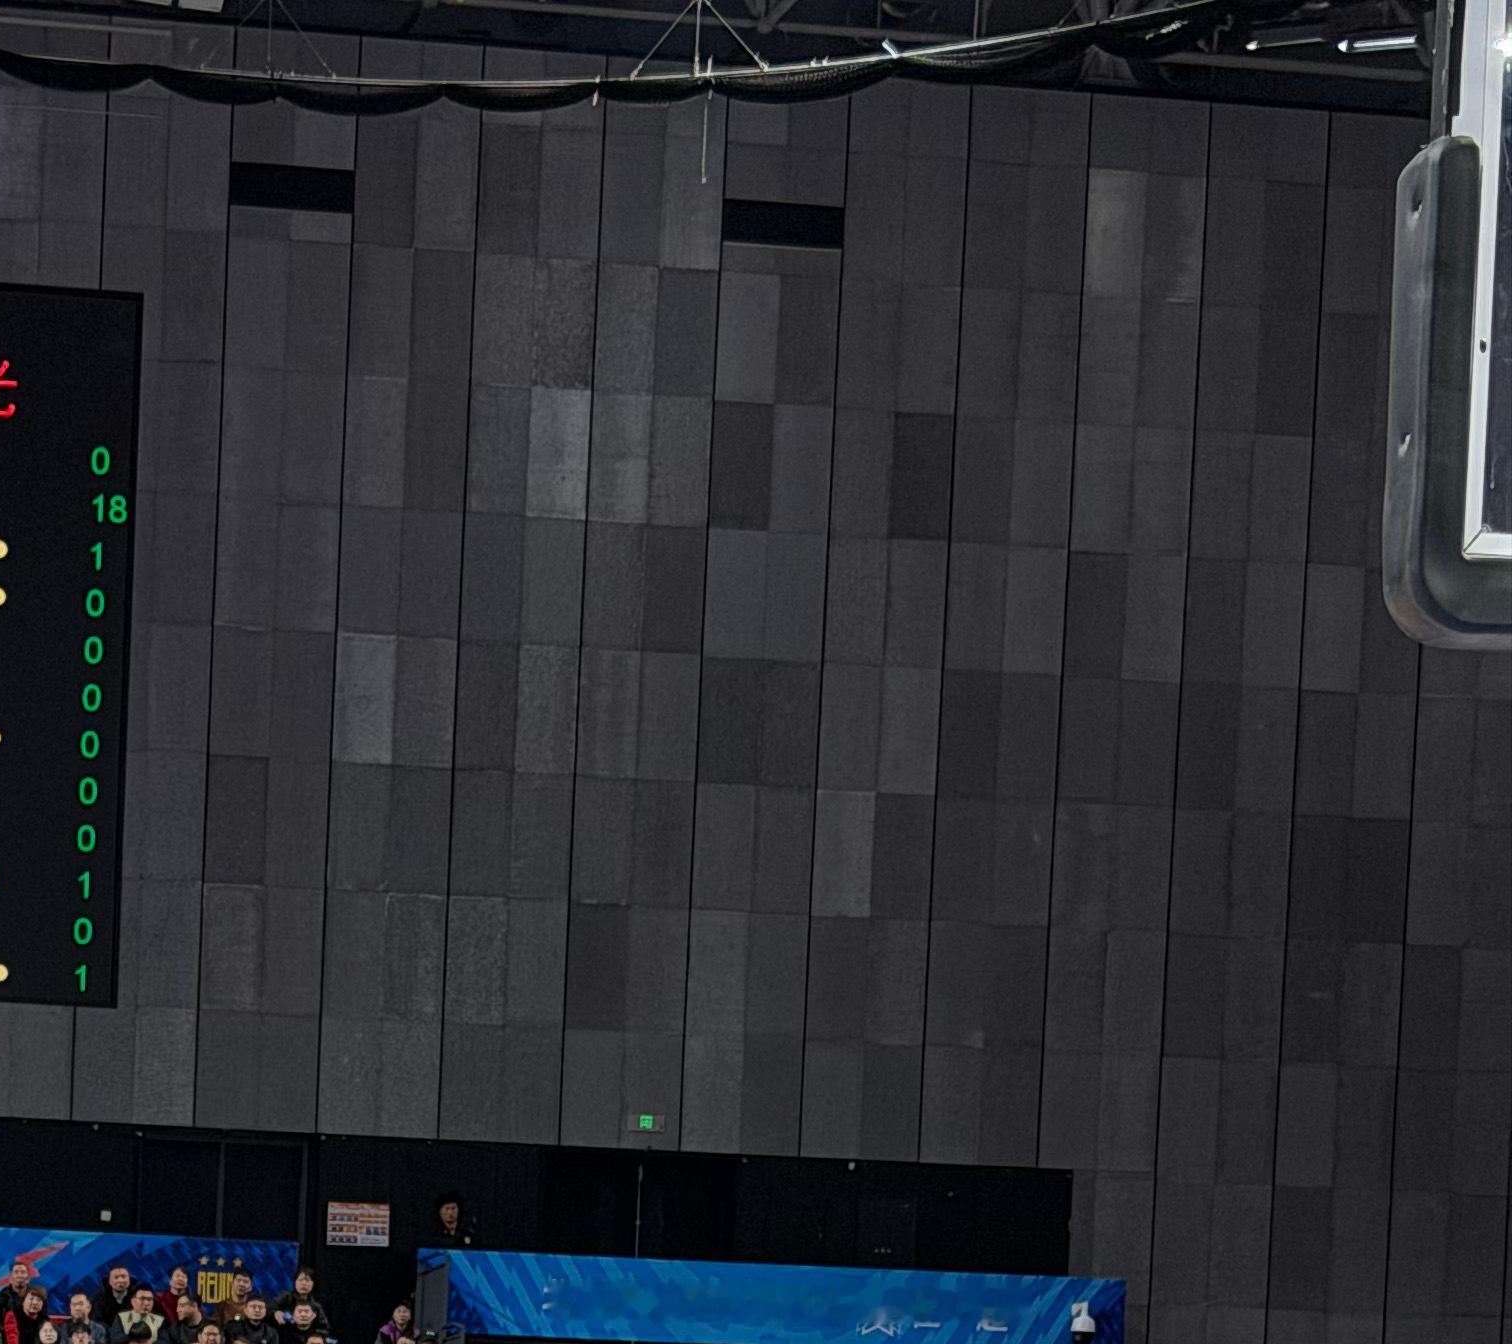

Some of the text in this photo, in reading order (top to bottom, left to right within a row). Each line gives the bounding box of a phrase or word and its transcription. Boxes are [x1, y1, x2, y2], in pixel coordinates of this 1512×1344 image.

[92, 448, 109, 474] 0
[93, 495, 127, 523] 18
[92, 543, 101, 569] 1
[87, 589, 104, 616] 0
[85, 637, 102, 663] 0
[83, 684, 101, 711] 0
[81, 731, 99, 758] 0
[80, 778, 97, 804] 0
[78, 825, 95, 851] 0
[79, 872, 89, 898] 1
[74, 918, 92, 944] 0
[76, 965, 86, 991] 1
